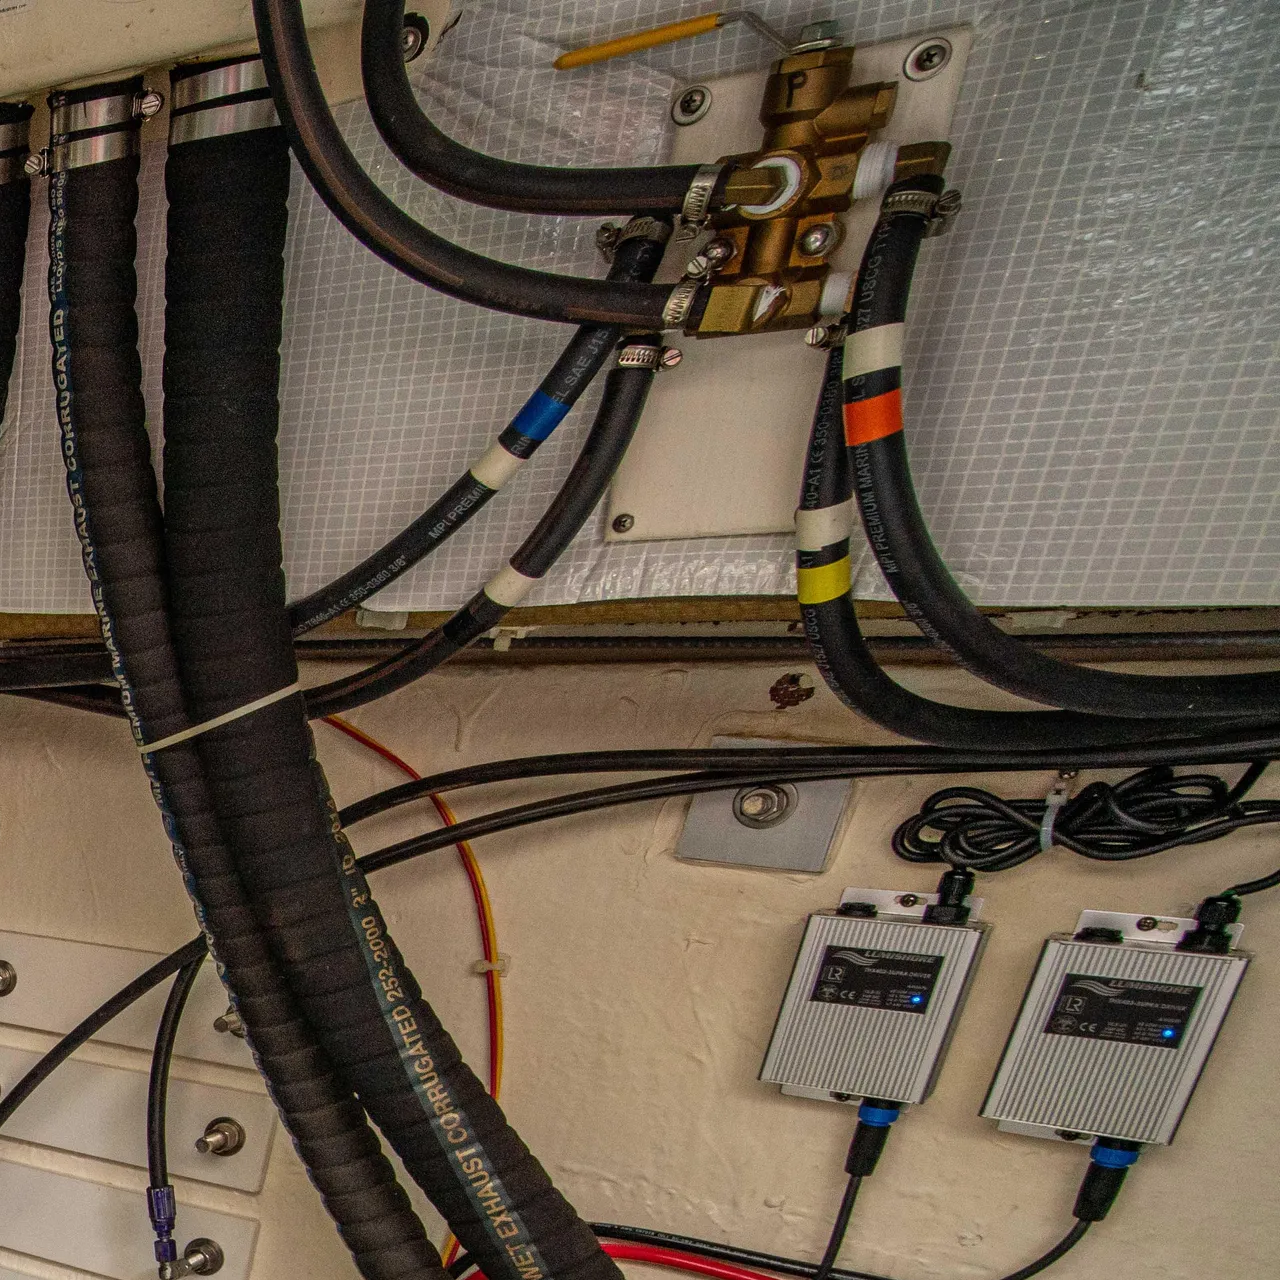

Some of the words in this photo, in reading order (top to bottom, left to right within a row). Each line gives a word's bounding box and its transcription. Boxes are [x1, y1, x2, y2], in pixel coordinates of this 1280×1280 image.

[52, 308, 78, 473] CORRUGATED
[854, 443, 872, 490] MARIN
[69, 479, 99, 581] EXHAUST
[361, 915, 405, 1003] 252-2000
[391, 1004, 468, 1145] CORRUGATED
[455, 1148, 519, 1240] EXHAUST
